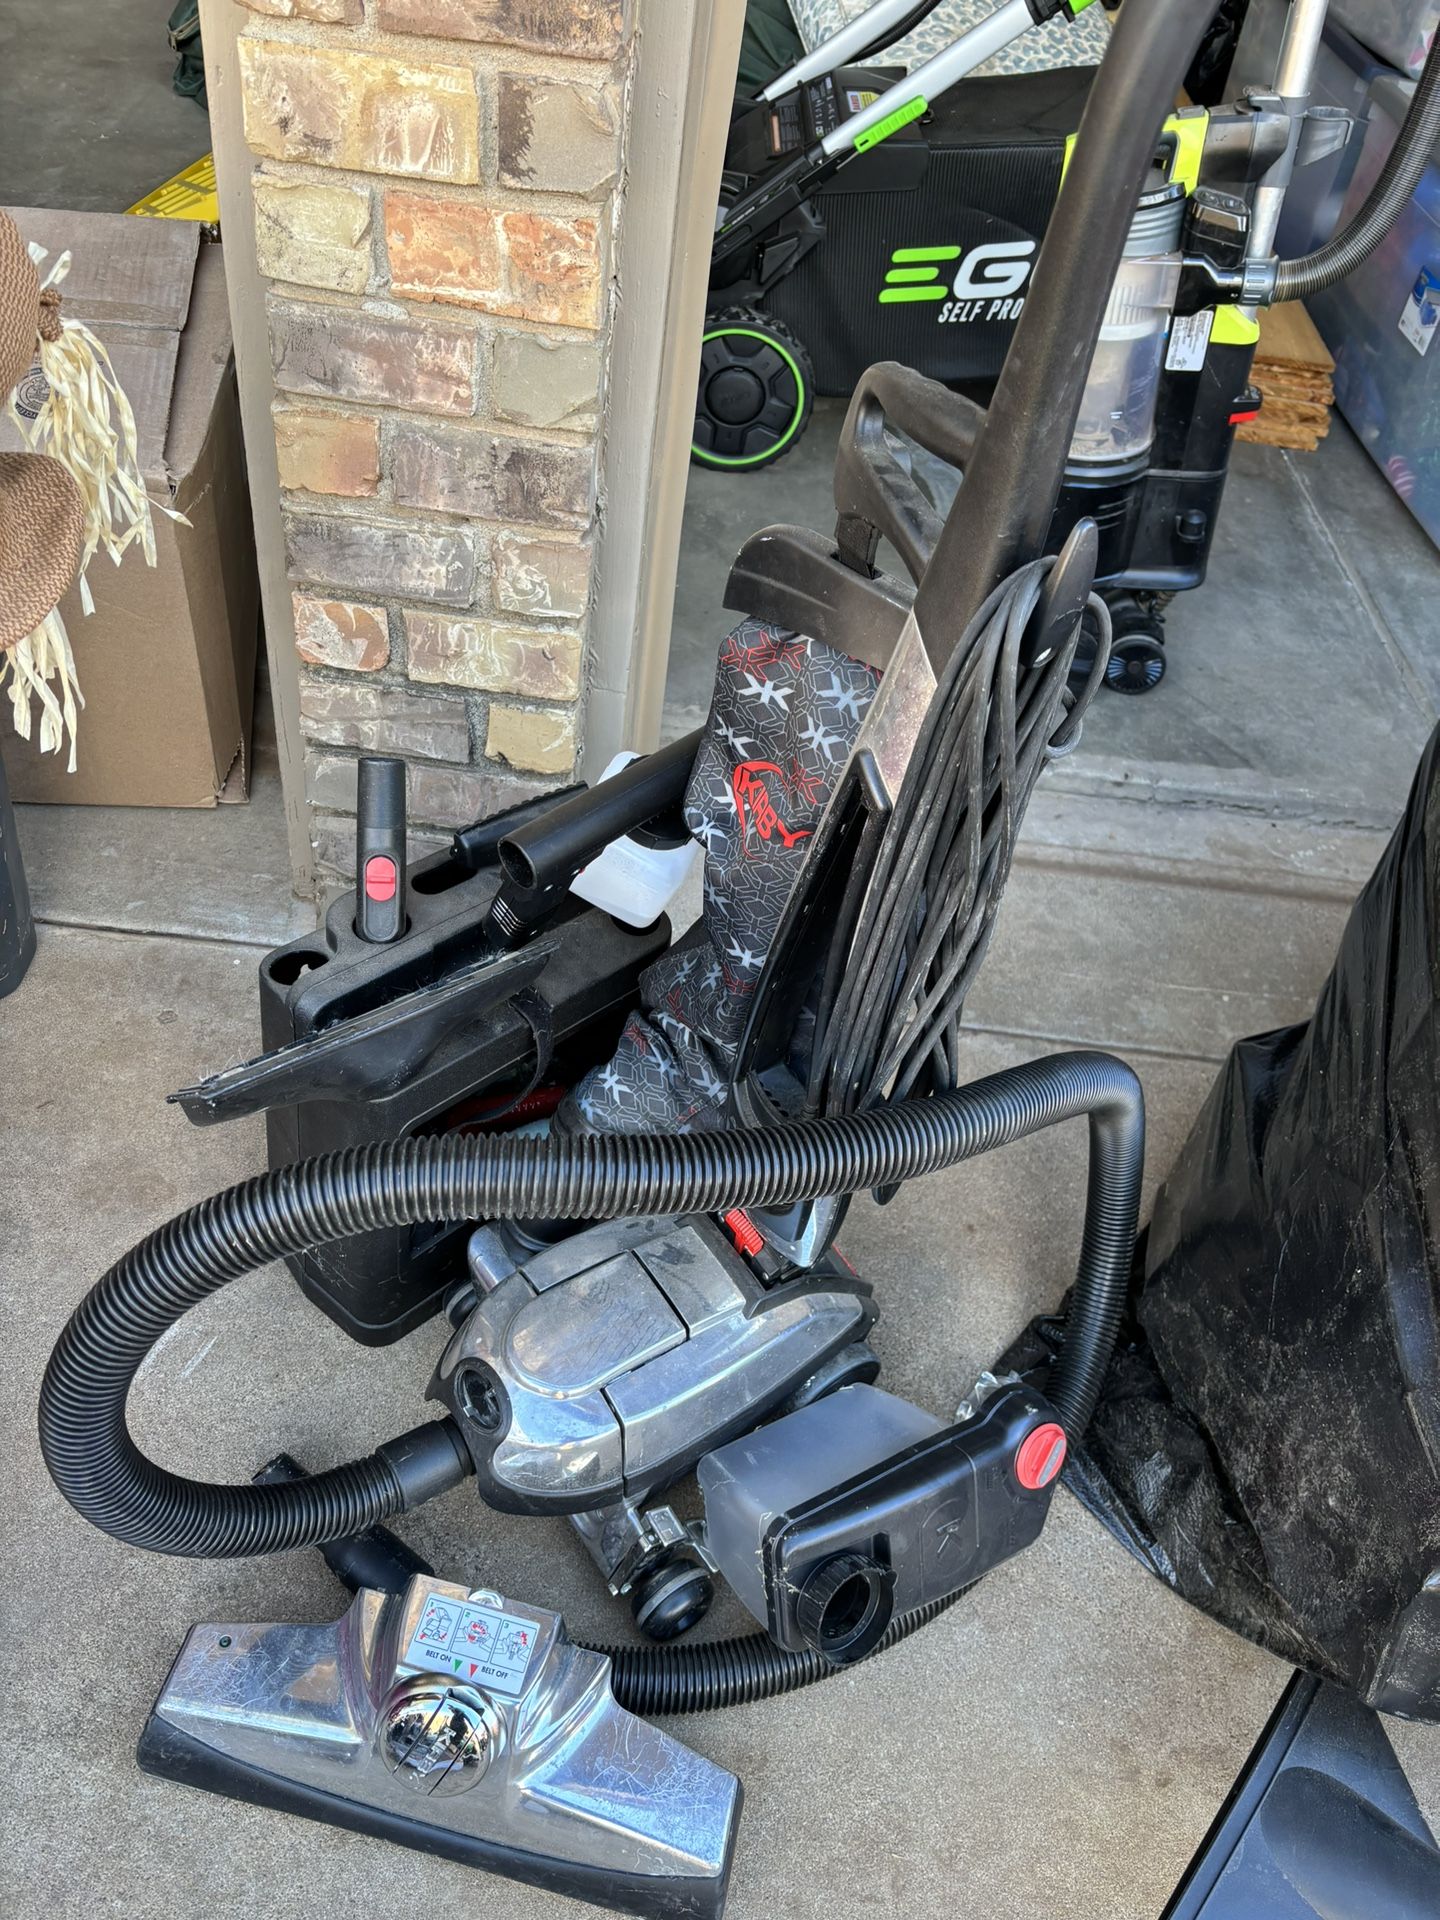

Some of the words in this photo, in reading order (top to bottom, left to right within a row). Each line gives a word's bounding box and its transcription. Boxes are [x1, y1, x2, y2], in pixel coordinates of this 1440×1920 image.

[879, 241, 1035, 303] EG
[937, 300, 986, 323] SELF
[986, 297, 1025, 321] PRO
[738, 766, 814, 849] KIRBY
[426, 1649, 440, 1659] BELT
[440, 1654, 452, 1663] ON
[481, 1666, 495, 1675] BELT
[496, 1670, 509, 1679] OFF
